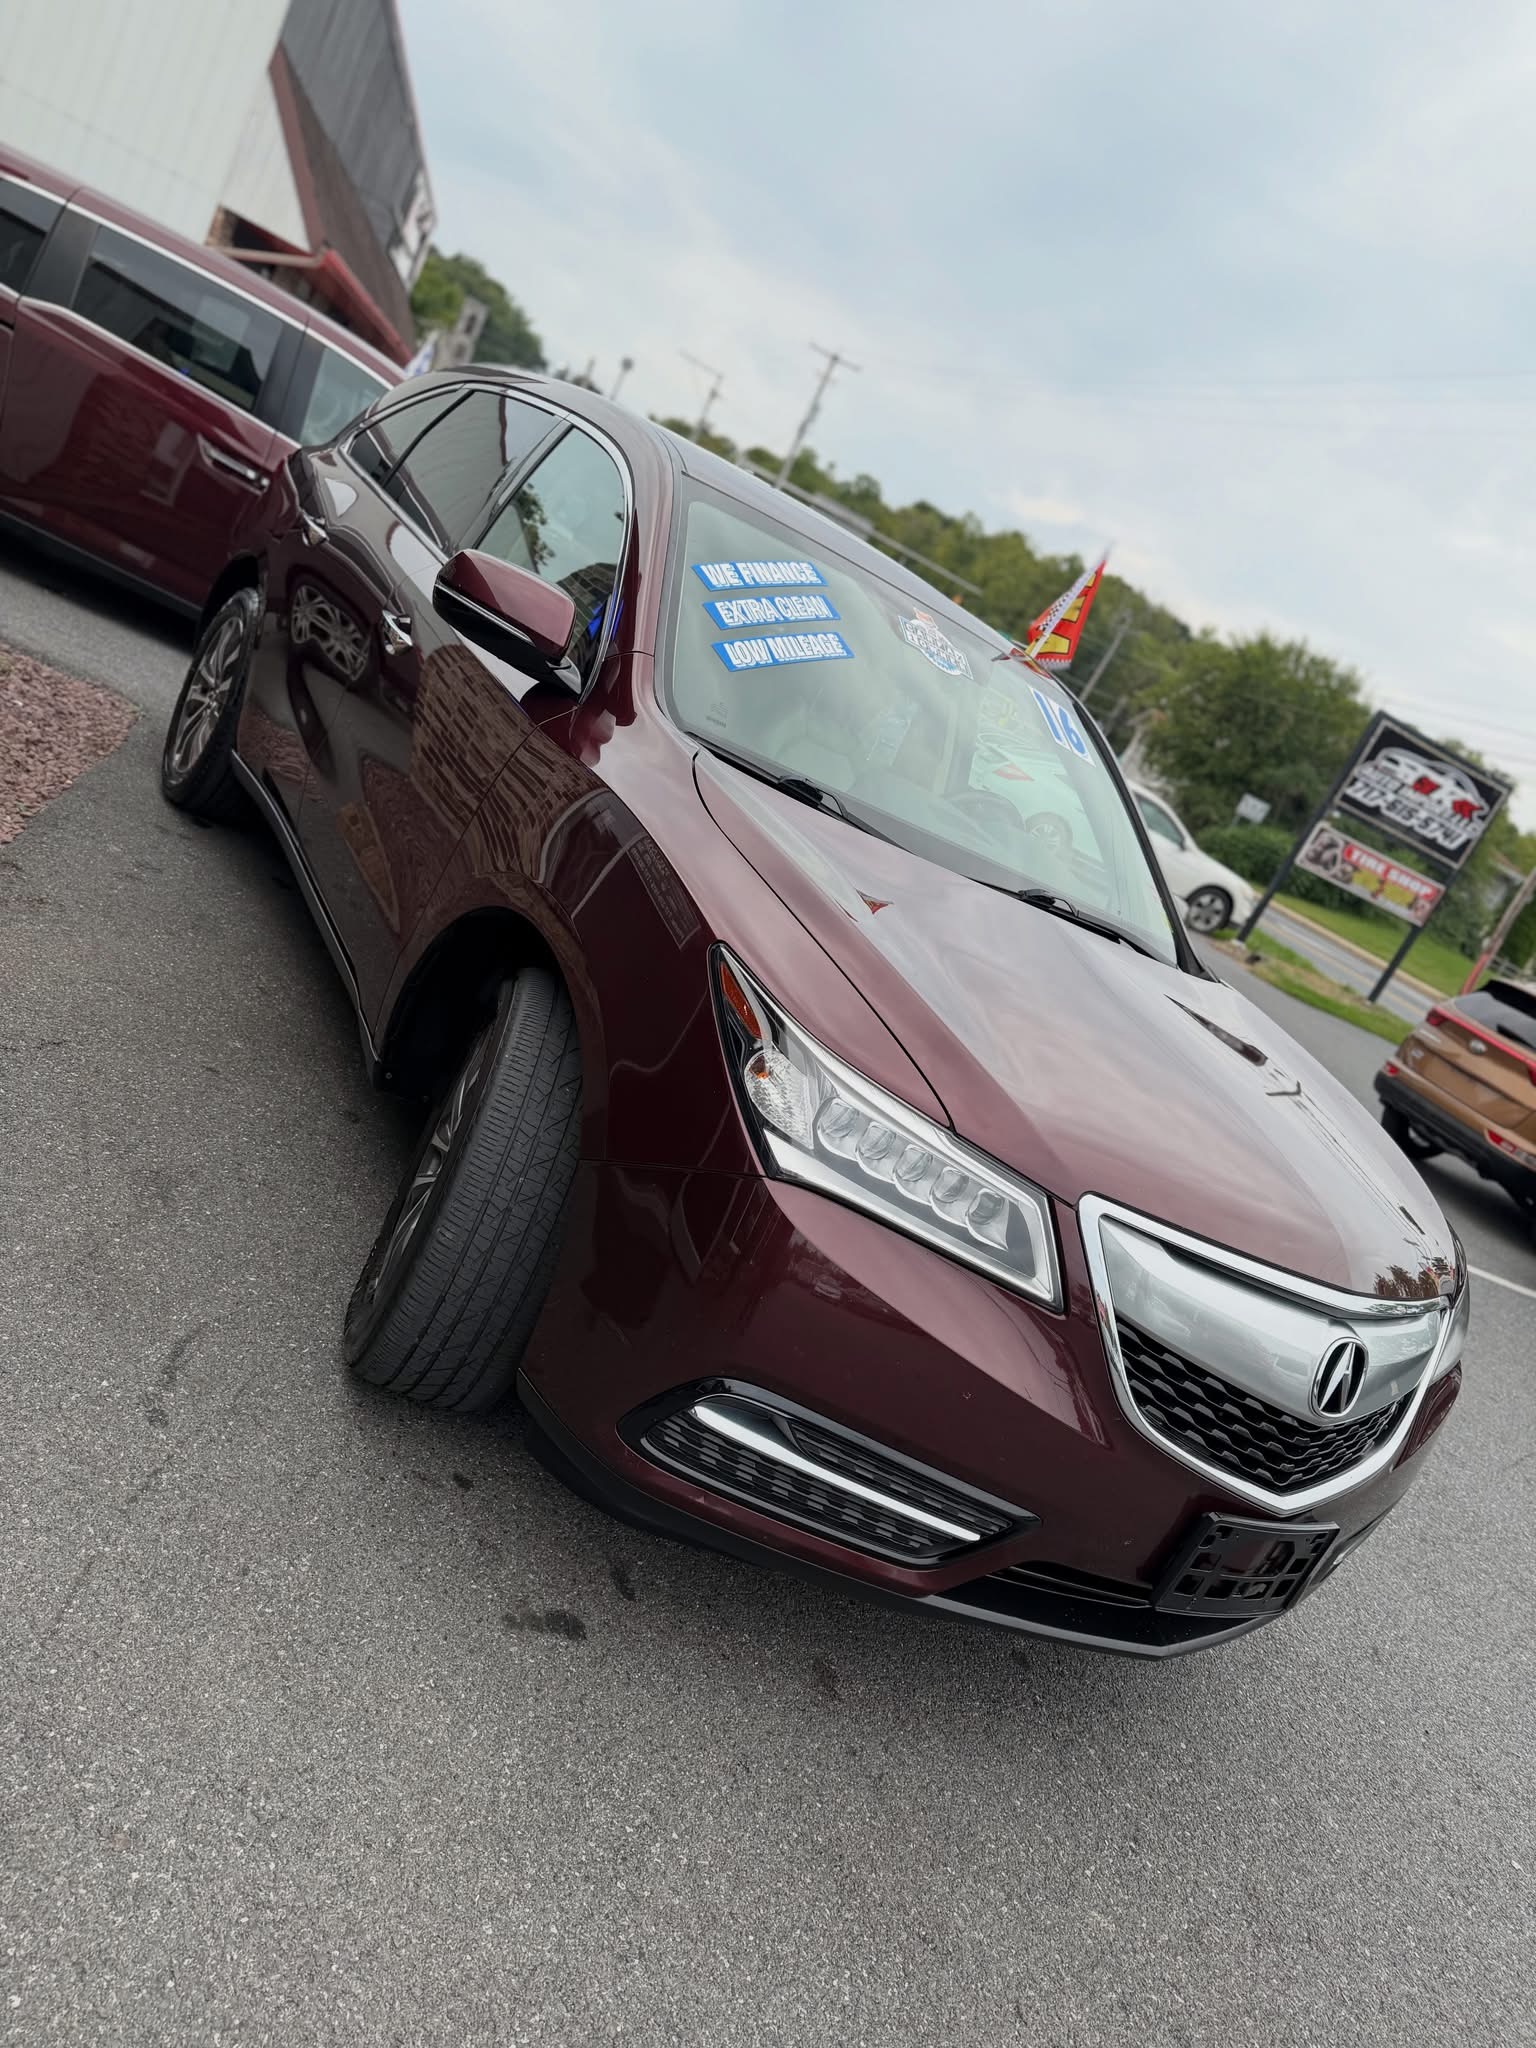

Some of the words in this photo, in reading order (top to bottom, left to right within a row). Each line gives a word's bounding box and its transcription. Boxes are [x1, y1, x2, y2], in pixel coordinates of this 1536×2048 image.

[700, 563, 744, 587] WE
[737, 561, 822, 586] FINANCE
[714, 599, 784, 627] EXTRA
[775, 595, 833, 620] CLEAN
[724, 639, 773, 668] LOW
[767, 634, 847, 661] MILEAGE
[1032, 687, 1090, 759] 16
[1351, 848, 1386, 875] TIRE
[1386, 868, 1432, 899] SHOP
